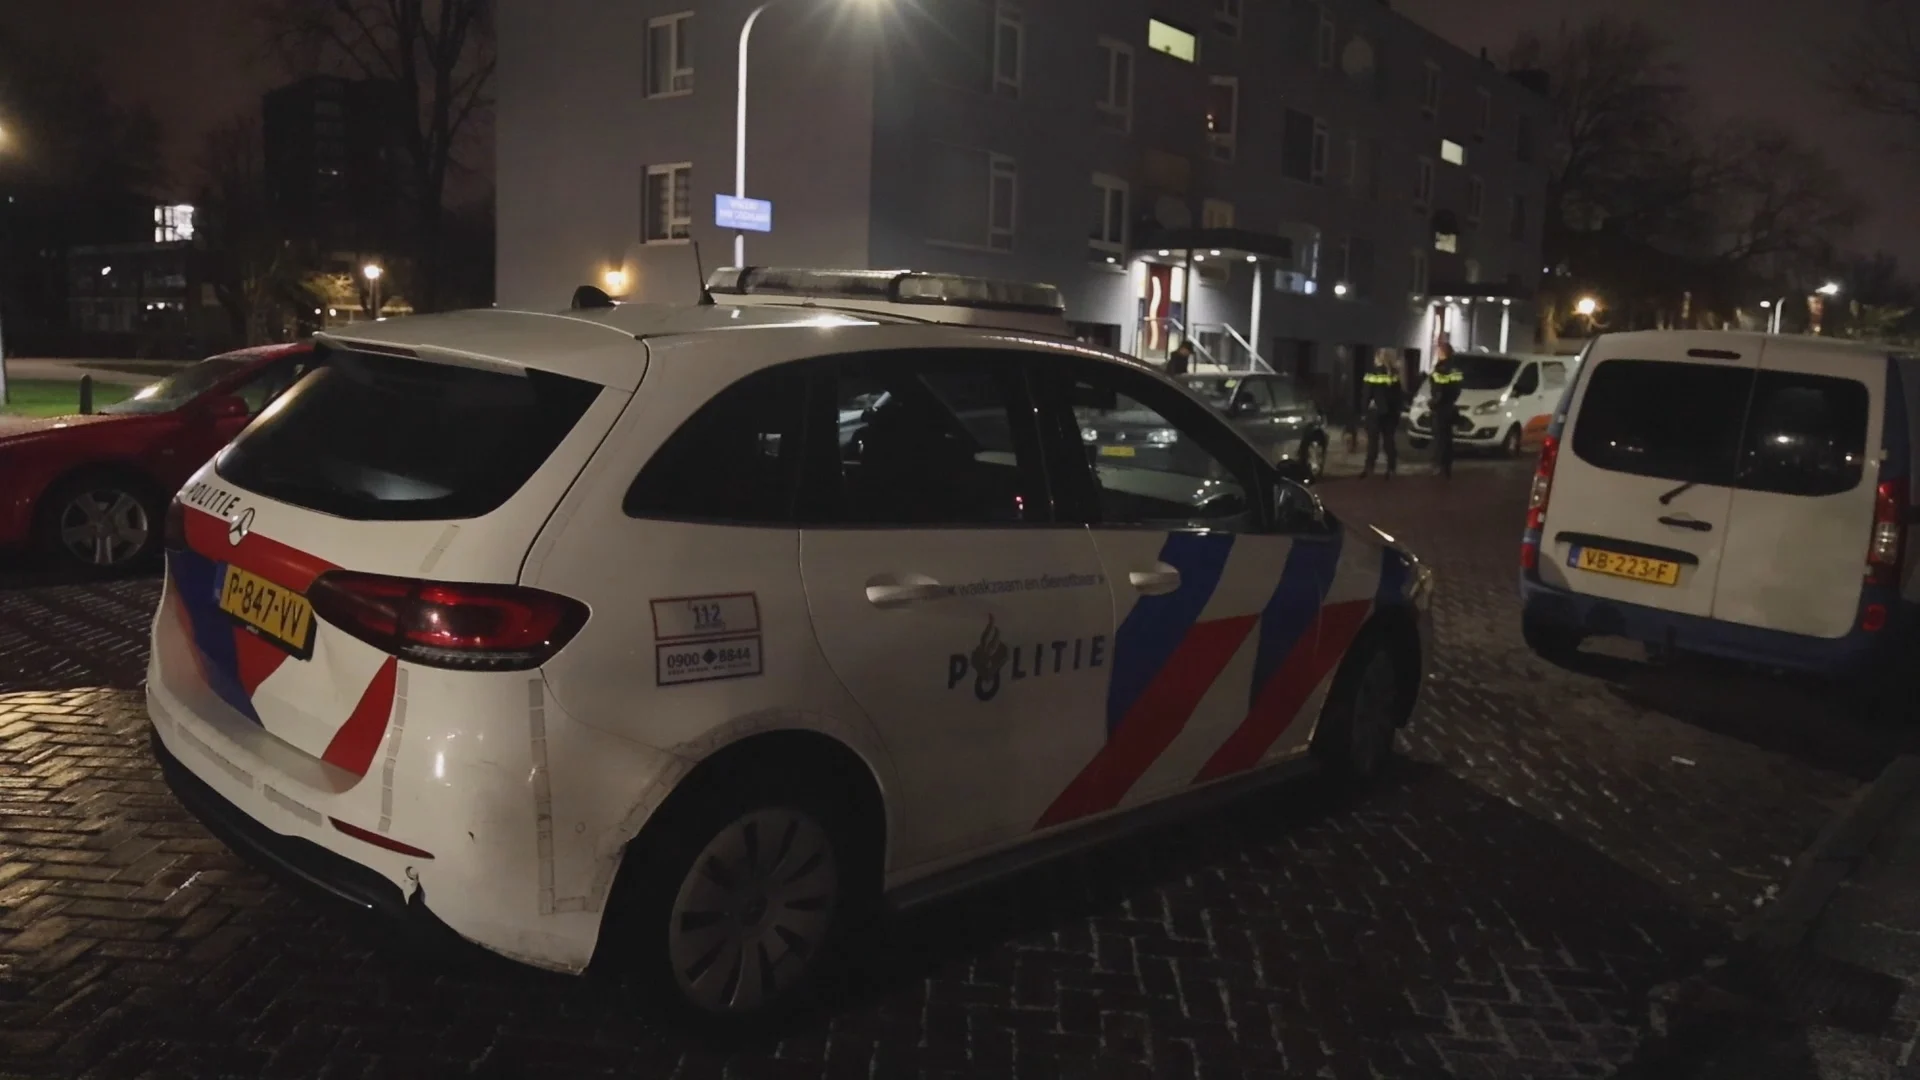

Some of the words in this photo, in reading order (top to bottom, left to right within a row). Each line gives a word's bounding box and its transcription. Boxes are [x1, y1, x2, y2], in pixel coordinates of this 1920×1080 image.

[188, 482, 240, 517] POLITIE
[1586, 551, 1668, 578] VB-223-F
[227, 573, 303, 638] P-847-VV
[692, 602, 721, 623] 112
[667, 652, 700, 668] 0900
[948, 635, 1105, 701] POLITIE
